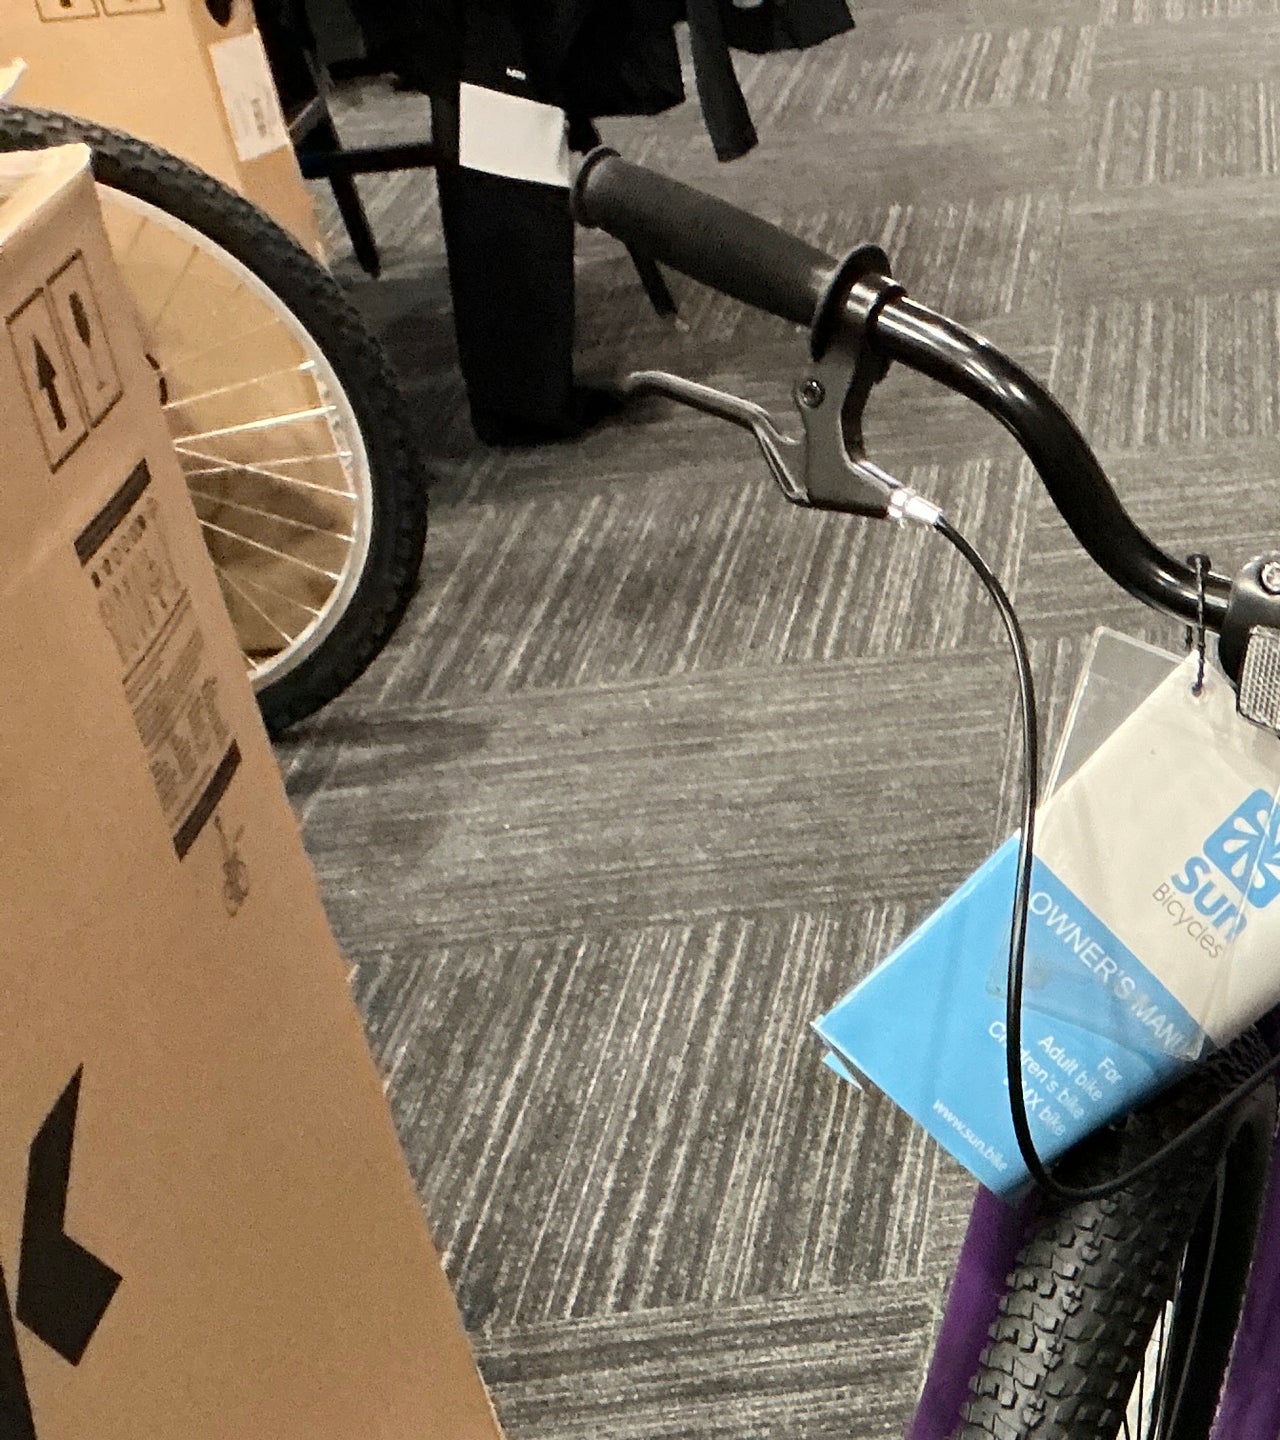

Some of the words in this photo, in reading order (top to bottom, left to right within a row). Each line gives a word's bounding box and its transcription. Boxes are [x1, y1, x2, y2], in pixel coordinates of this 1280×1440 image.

[1029, 892, 1136, 1000] OWNER'S
[1152, 882, 1223, 959] Bicycles
[1037, 1035, 1079, 1077] Adult
[1075, 1070, 1103, 1101] bike
[1098, 1056, 1123, 1085] For
[933, 1099, 1008, 1171] www.sun.bike
[1039, 1105, 1066, 1136] bike
[1056, 1088, 1084, 1119] bike
